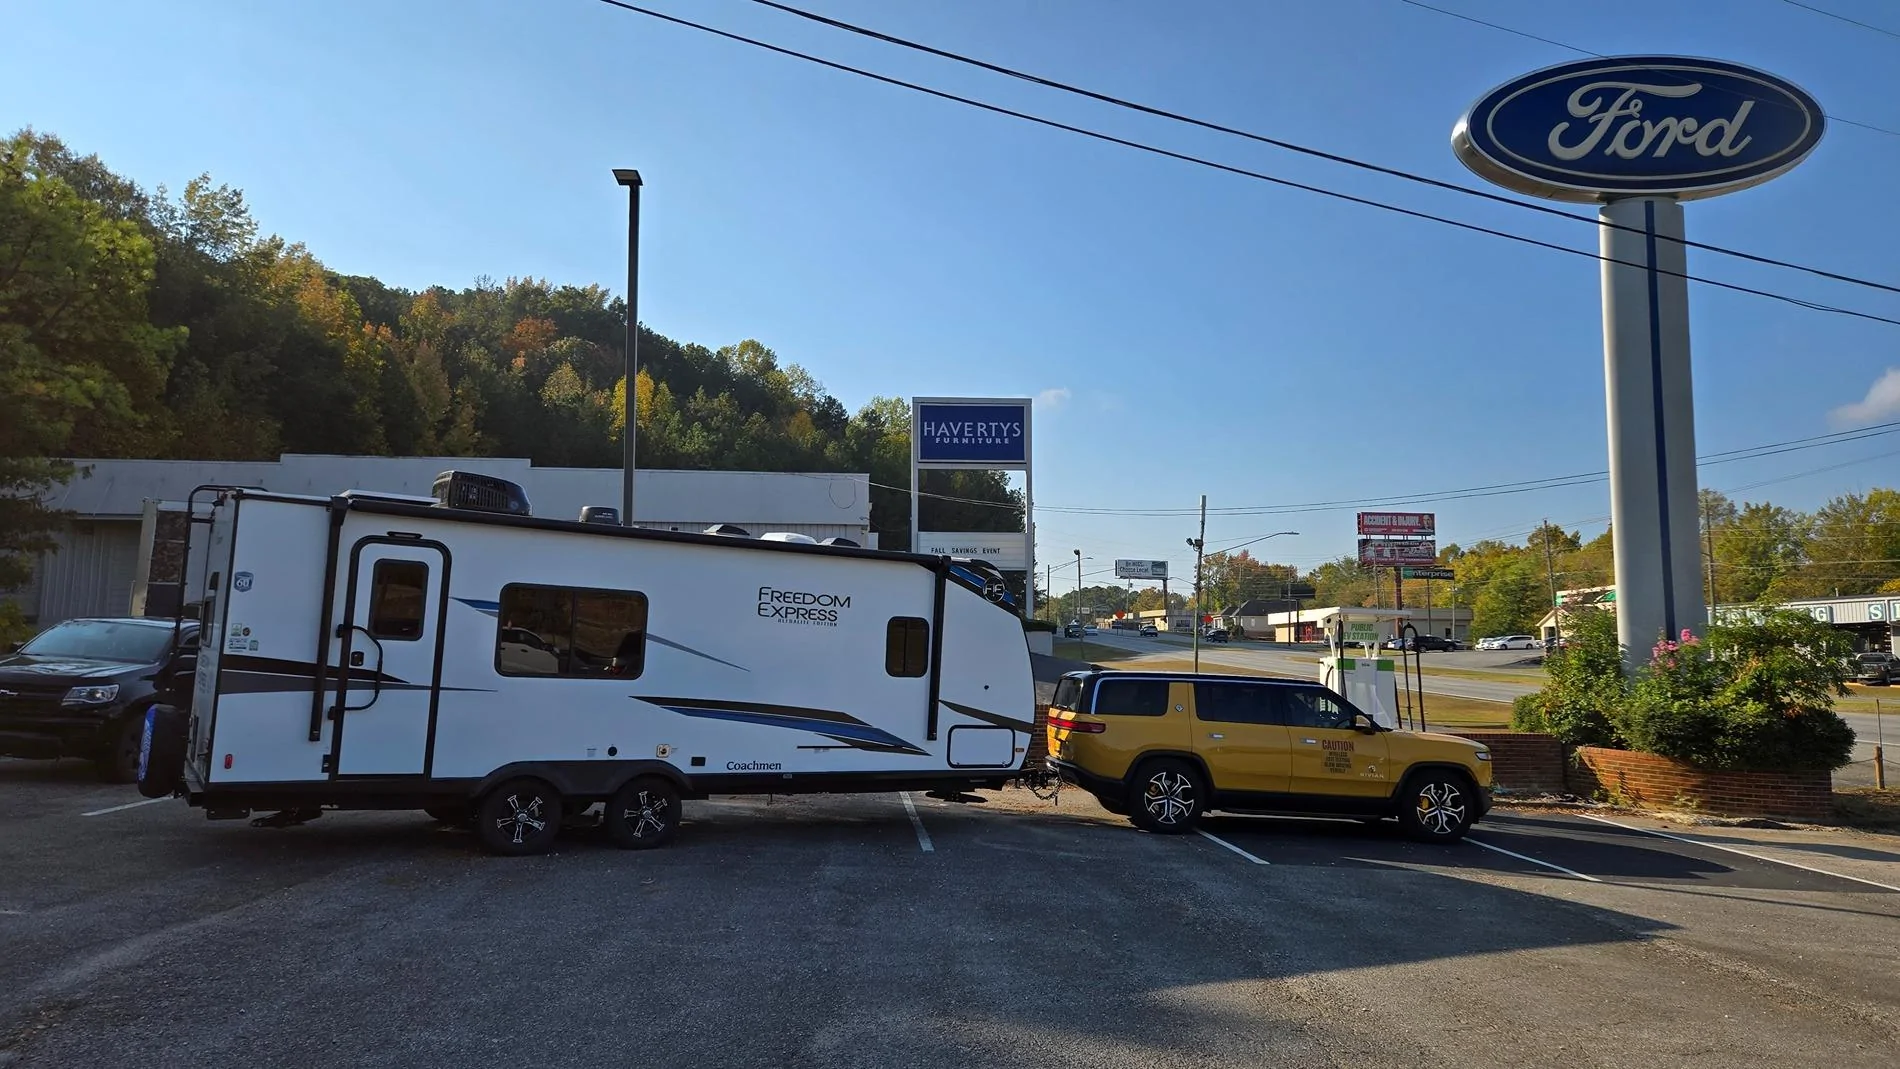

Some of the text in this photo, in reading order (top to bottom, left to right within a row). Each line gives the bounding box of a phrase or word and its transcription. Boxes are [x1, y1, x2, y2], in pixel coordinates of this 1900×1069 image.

[1548, 82, 1755, 161] Ford
[923, 422, 1021, 437] HAVERTYS
[935, 437, 1010, 445] FURNITURE
[1364, 515, 1392, 525] ACCIDENT
[758, 586, 851, 608] FREEDOM
[758, 602, 838, 621] EXPRESS
[1351, 623, 1373, 631] PUBLIC
[1352, 632, 1379, 641] STATION
[1322, 739, 1354, 752] CAUTION
[726, 760, 782, 771] Coachmen
